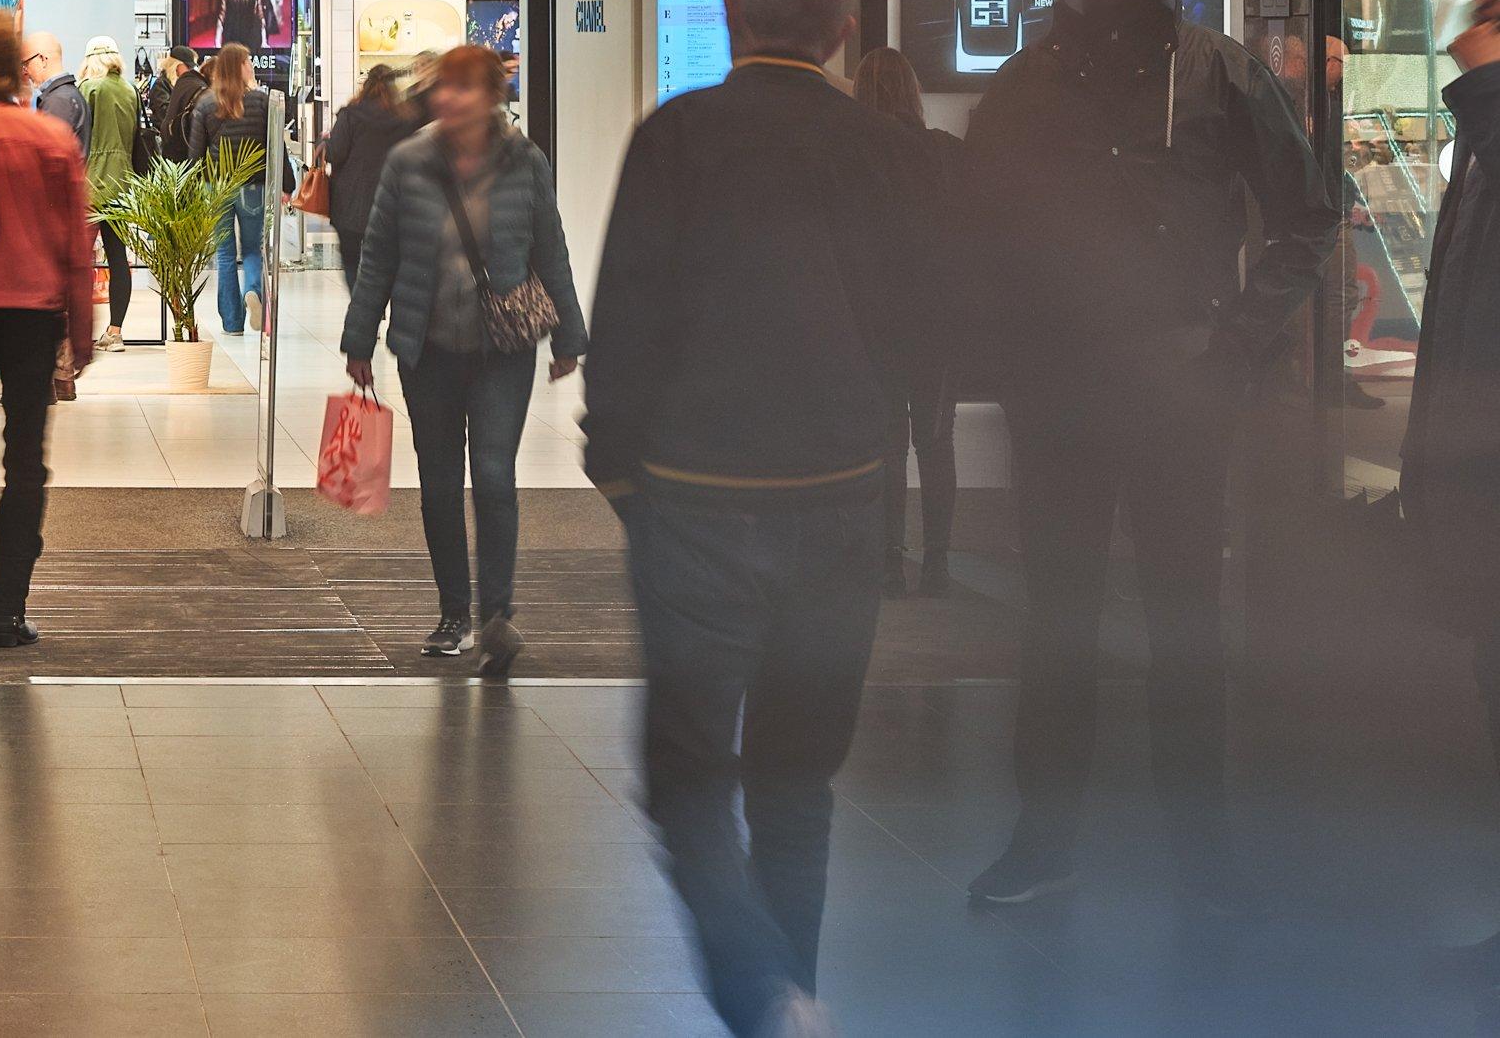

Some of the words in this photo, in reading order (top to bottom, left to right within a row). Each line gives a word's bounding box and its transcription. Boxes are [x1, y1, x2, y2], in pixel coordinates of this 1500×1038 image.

[575, 0, 606, 32] CHANEL
[664, 9, 671, 19] E
[664, 56, 670, 65] 2
[664, 70, 670, 79] 3
